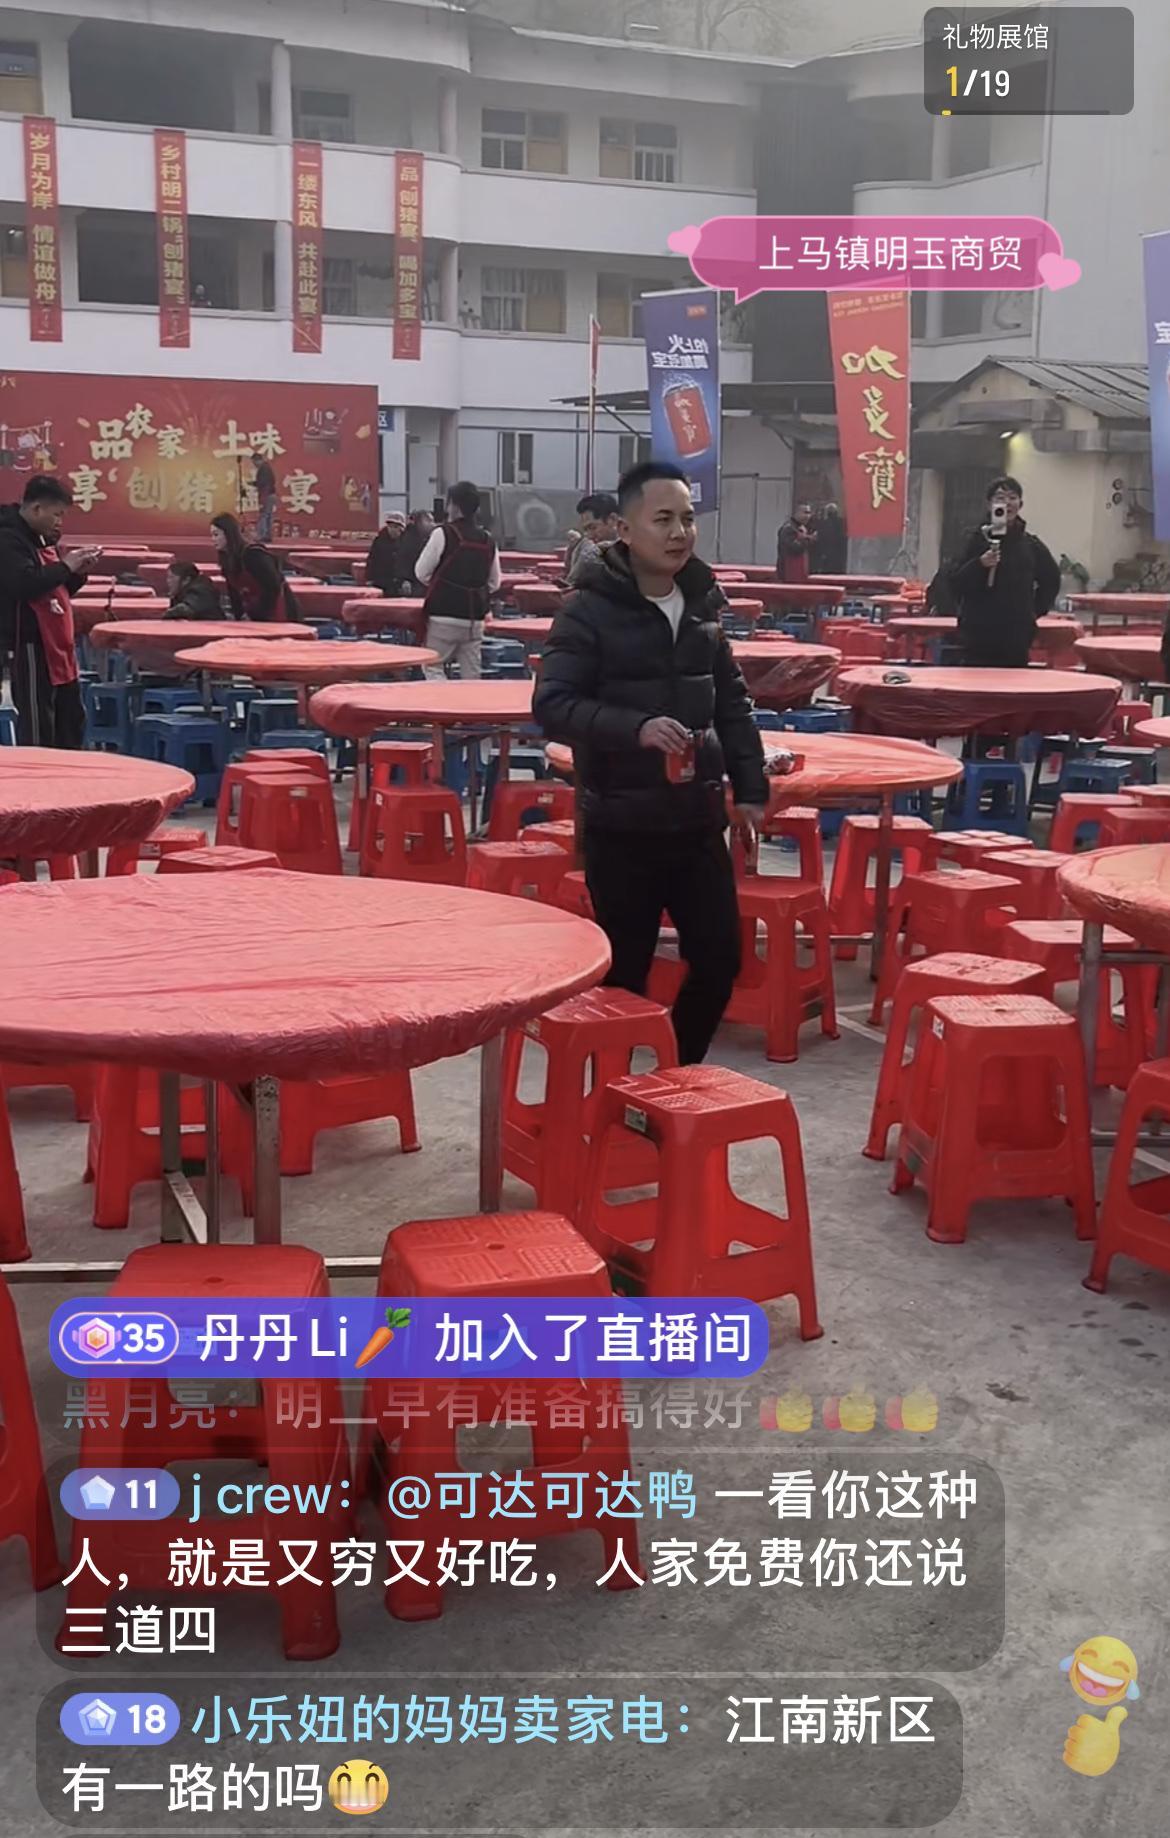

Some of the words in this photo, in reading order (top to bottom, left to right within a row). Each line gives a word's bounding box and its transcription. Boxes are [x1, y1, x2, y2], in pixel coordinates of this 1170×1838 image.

[297, 161, 318, 229] 一缕东风
[90, 403, 190, 461] 品农家
[213, 420, 287, 461] 土味
